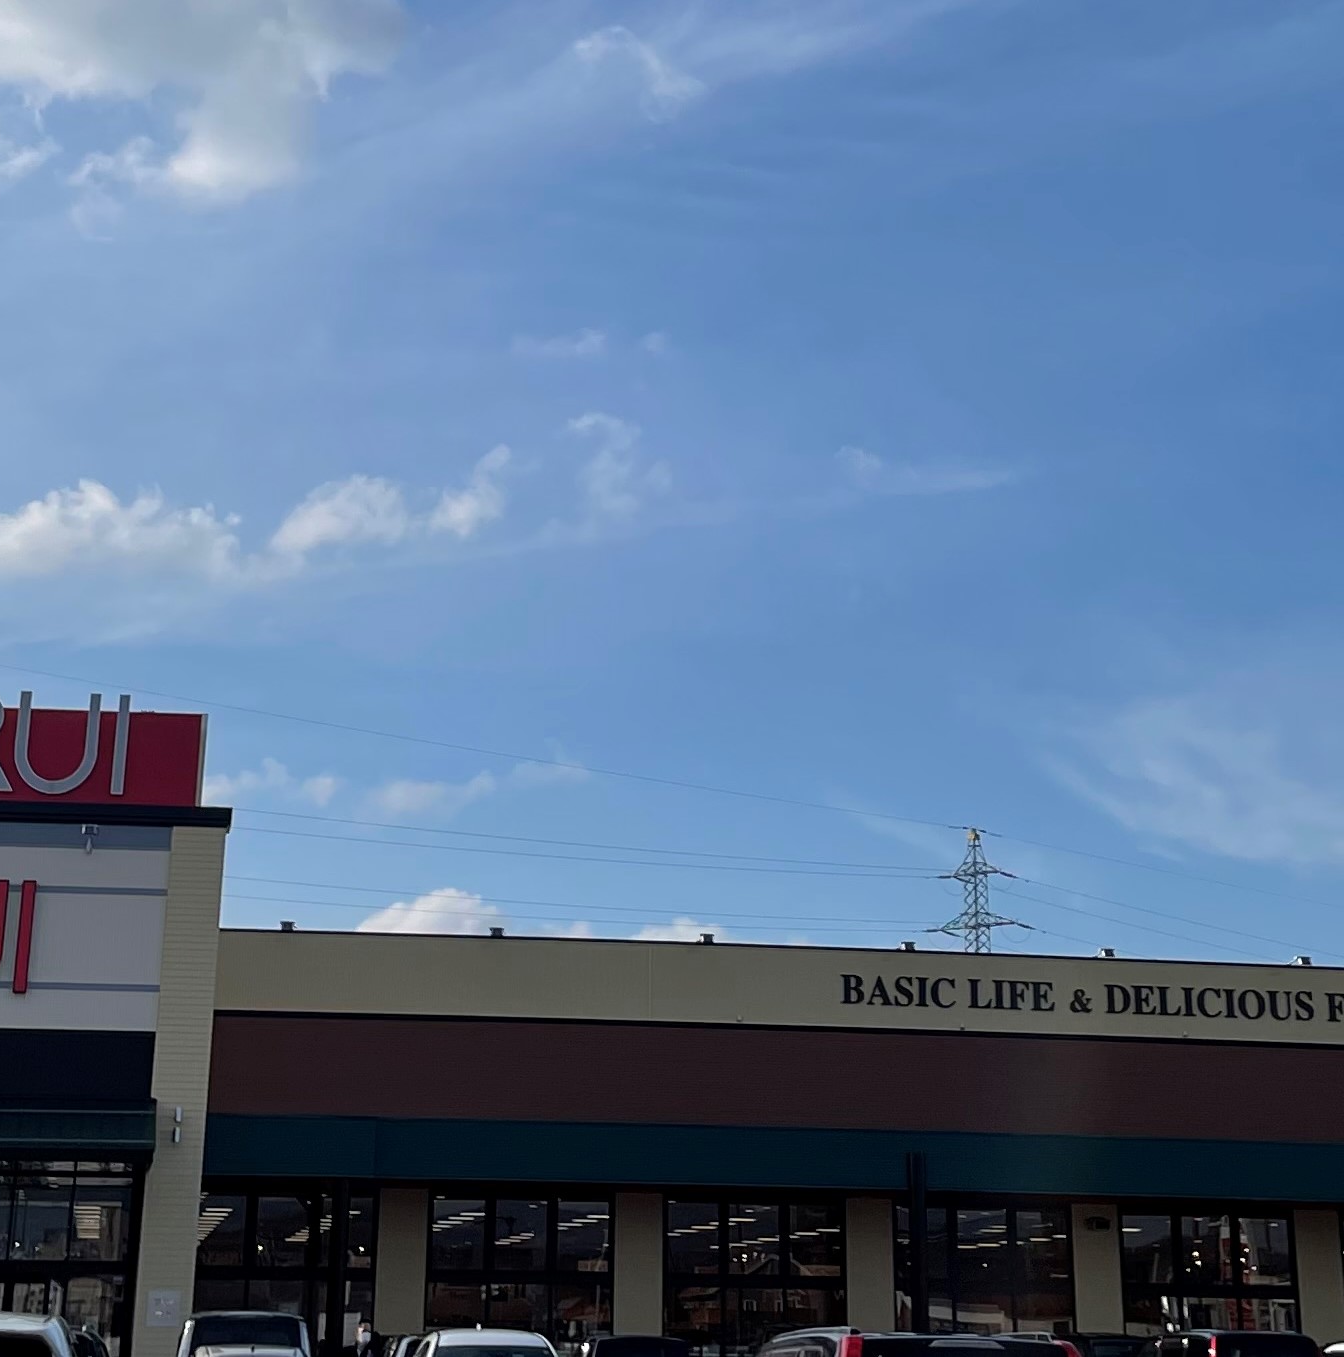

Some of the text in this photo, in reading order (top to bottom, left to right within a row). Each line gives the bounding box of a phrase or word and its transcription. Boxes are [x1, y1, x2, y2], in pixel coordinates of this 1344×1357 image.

[840, 973, 956, 1009] BASIC
[967, 980, 1056, 1011] LIFE
[1069, 989, 1093, 1013] &
[1104, 984, 1315, 1022] DELICIOUS
